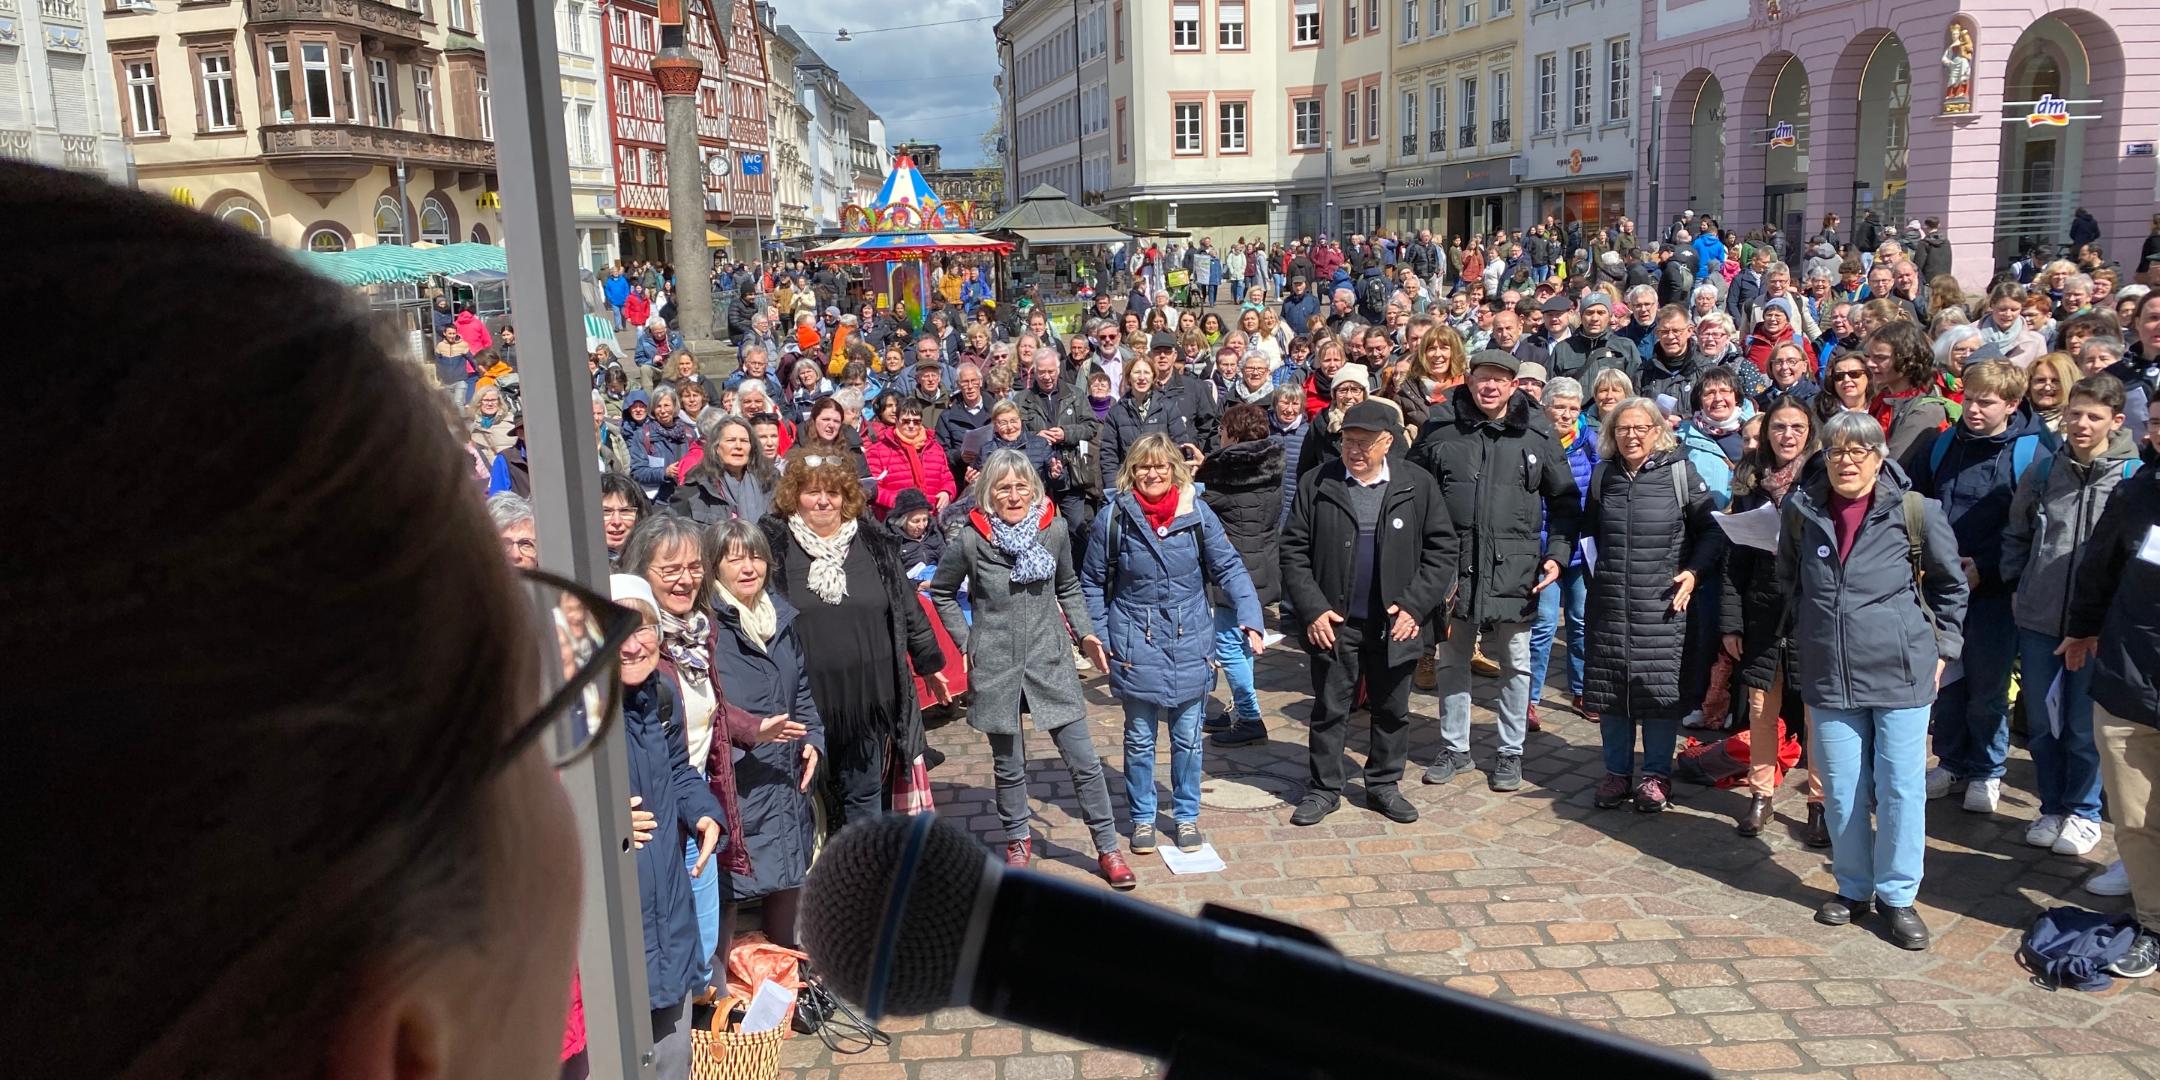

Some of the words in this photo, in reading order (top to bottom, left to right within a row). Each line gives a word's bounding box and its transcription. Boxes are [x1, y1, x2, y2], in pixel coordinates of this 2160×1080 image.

[2037, 96, 2065, 114] dm
[1776, 122, 1792, 138] dm
[743, 154, 762, 164] WC
[1405, 177, 1424, 188] zero
